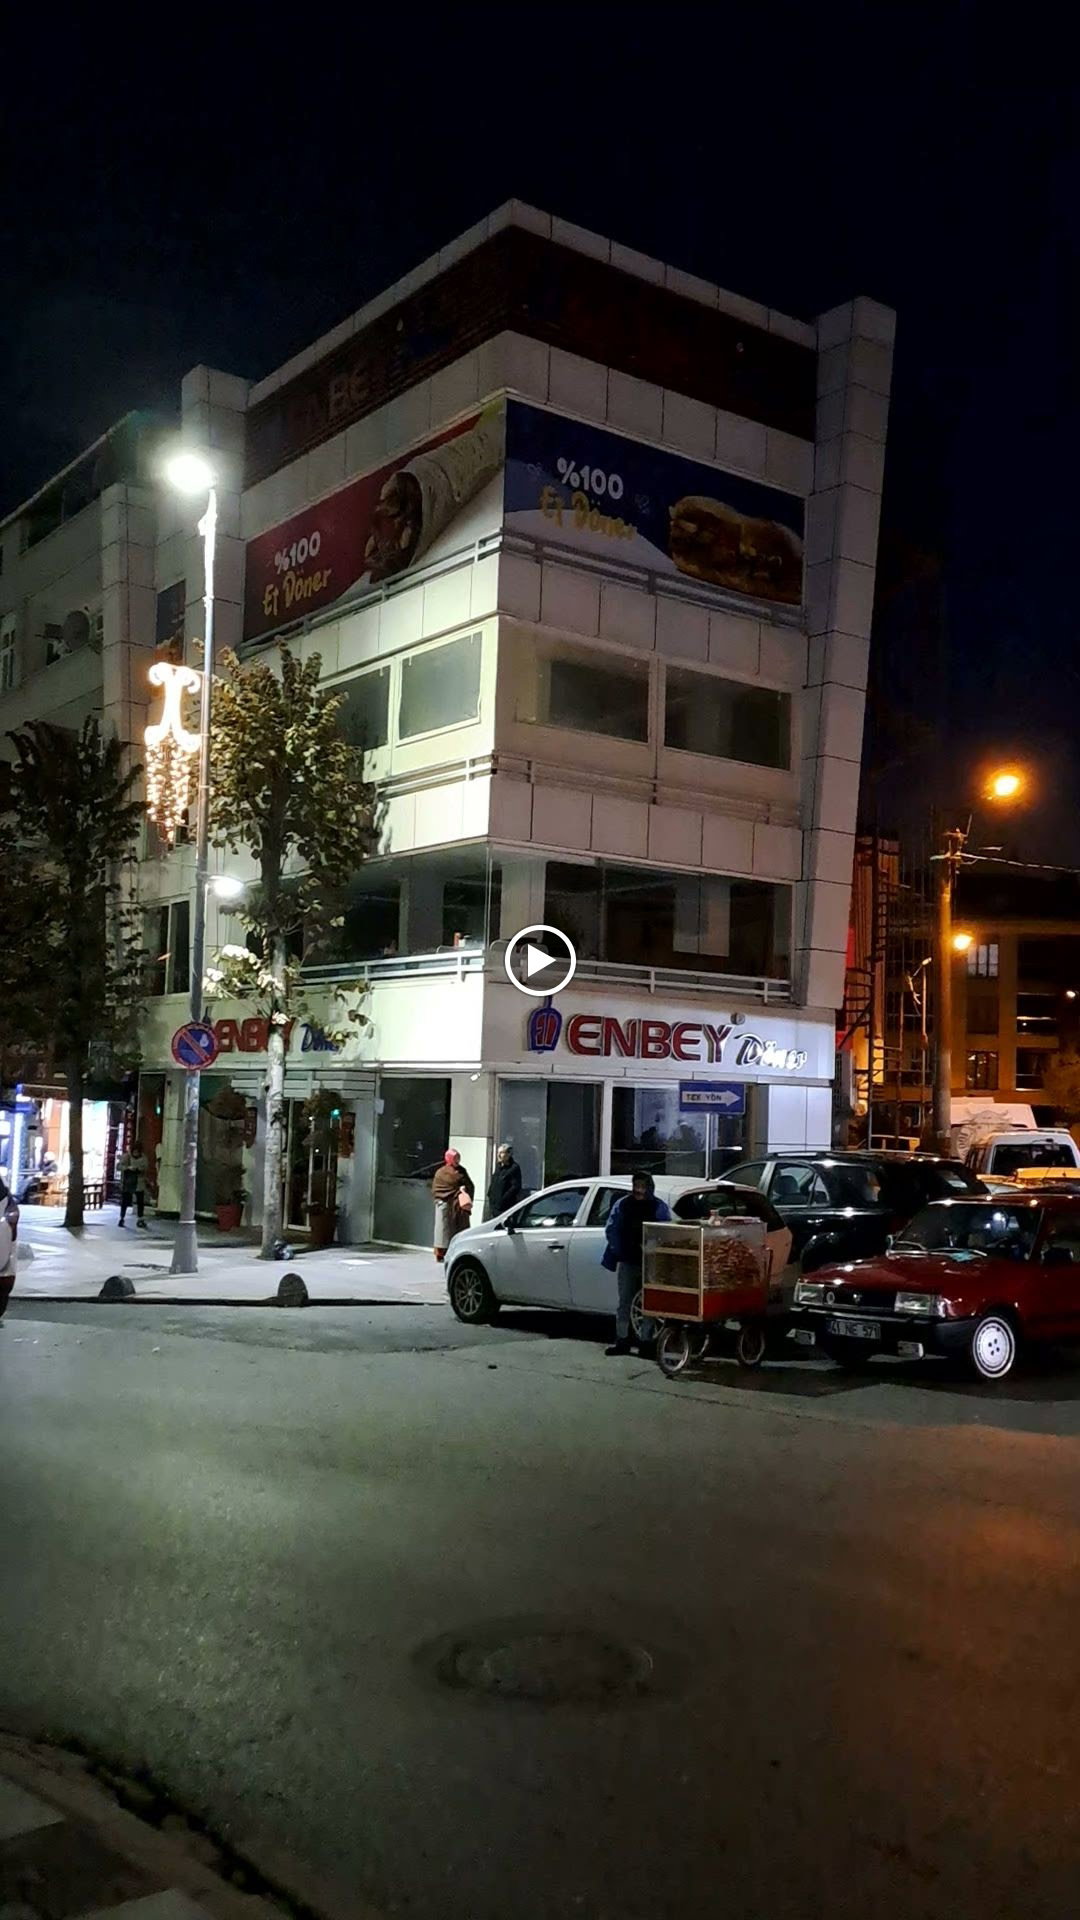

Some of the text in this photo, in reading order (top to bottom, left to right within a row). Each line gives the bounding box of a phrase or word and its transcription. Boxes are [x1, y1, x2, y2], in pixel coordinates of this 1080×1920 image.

[557, 457, 624, 500] %100
[274, 530, 321, 575] %100
[283, 569, 332, 608] Döner
[567, 1013, 732, 1064] ENBEY
[706, 1093, 722, 1101] YÖN
